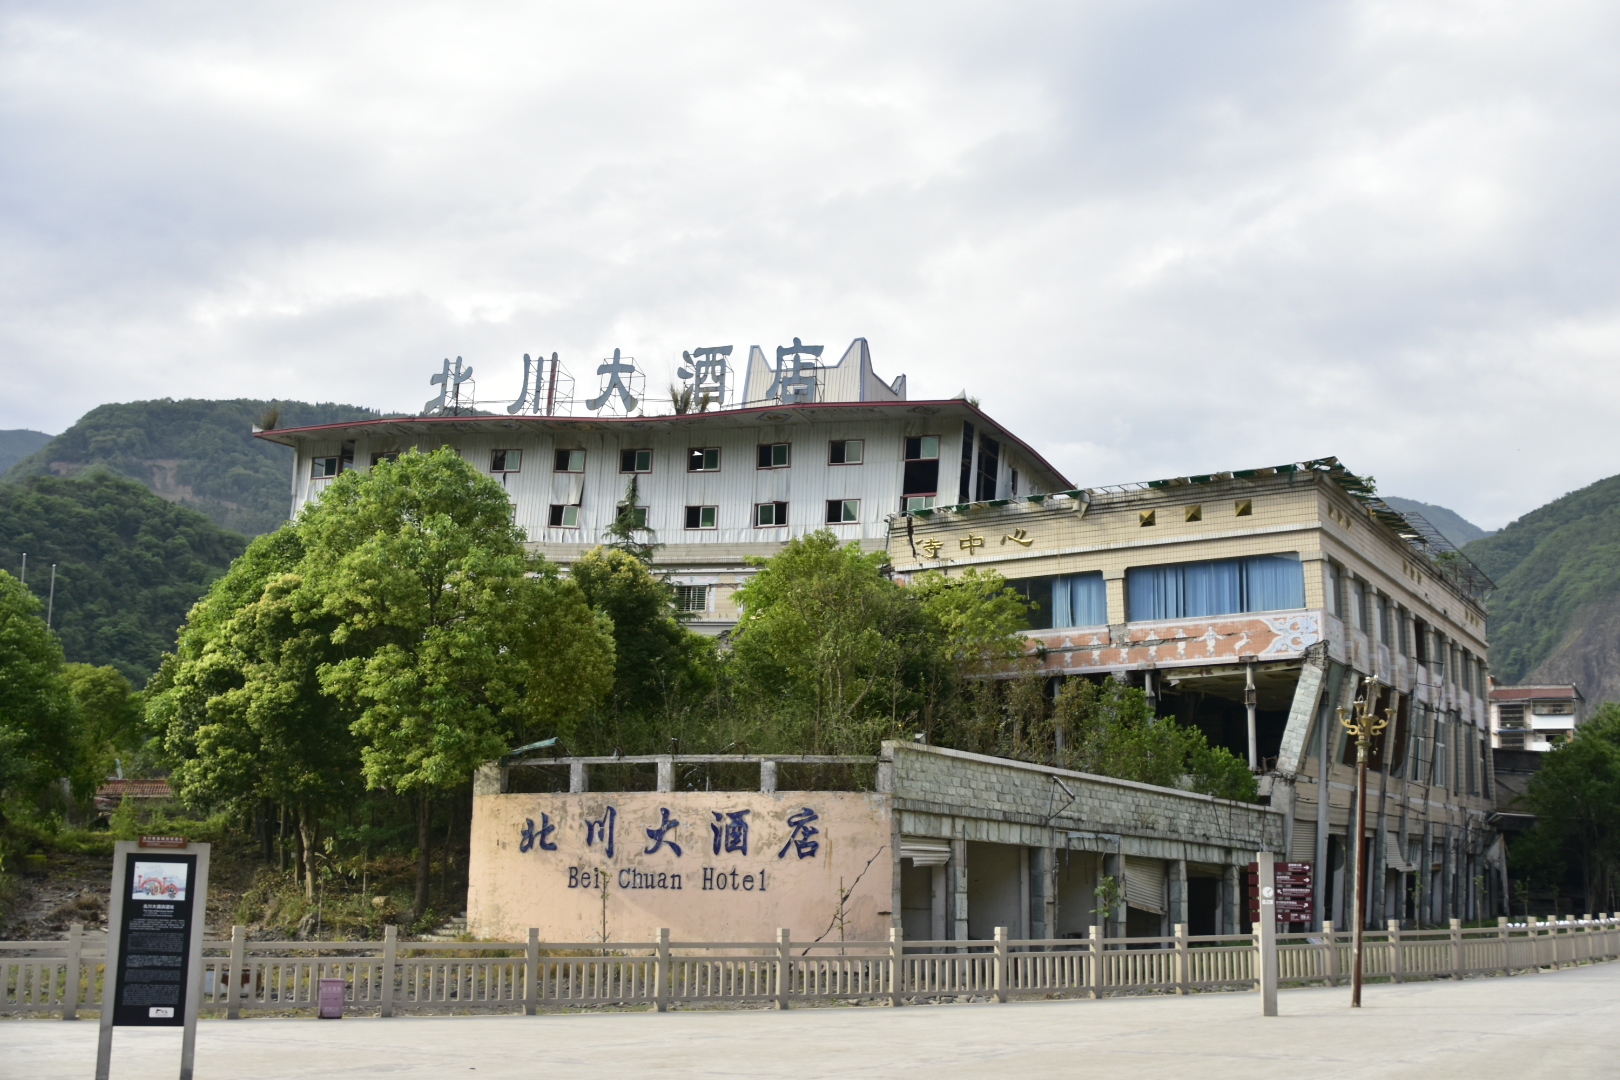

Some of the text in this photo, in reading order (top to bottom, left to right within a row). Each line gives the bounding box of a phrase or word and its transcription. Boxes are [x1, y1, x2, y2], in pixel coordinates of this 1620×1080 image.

[424, 337, 824, 417] 北川大酒店
[519, 805, 819, 860] 北川大酒店
[568, 867, 766, 891] Bei Chuan Hotel
